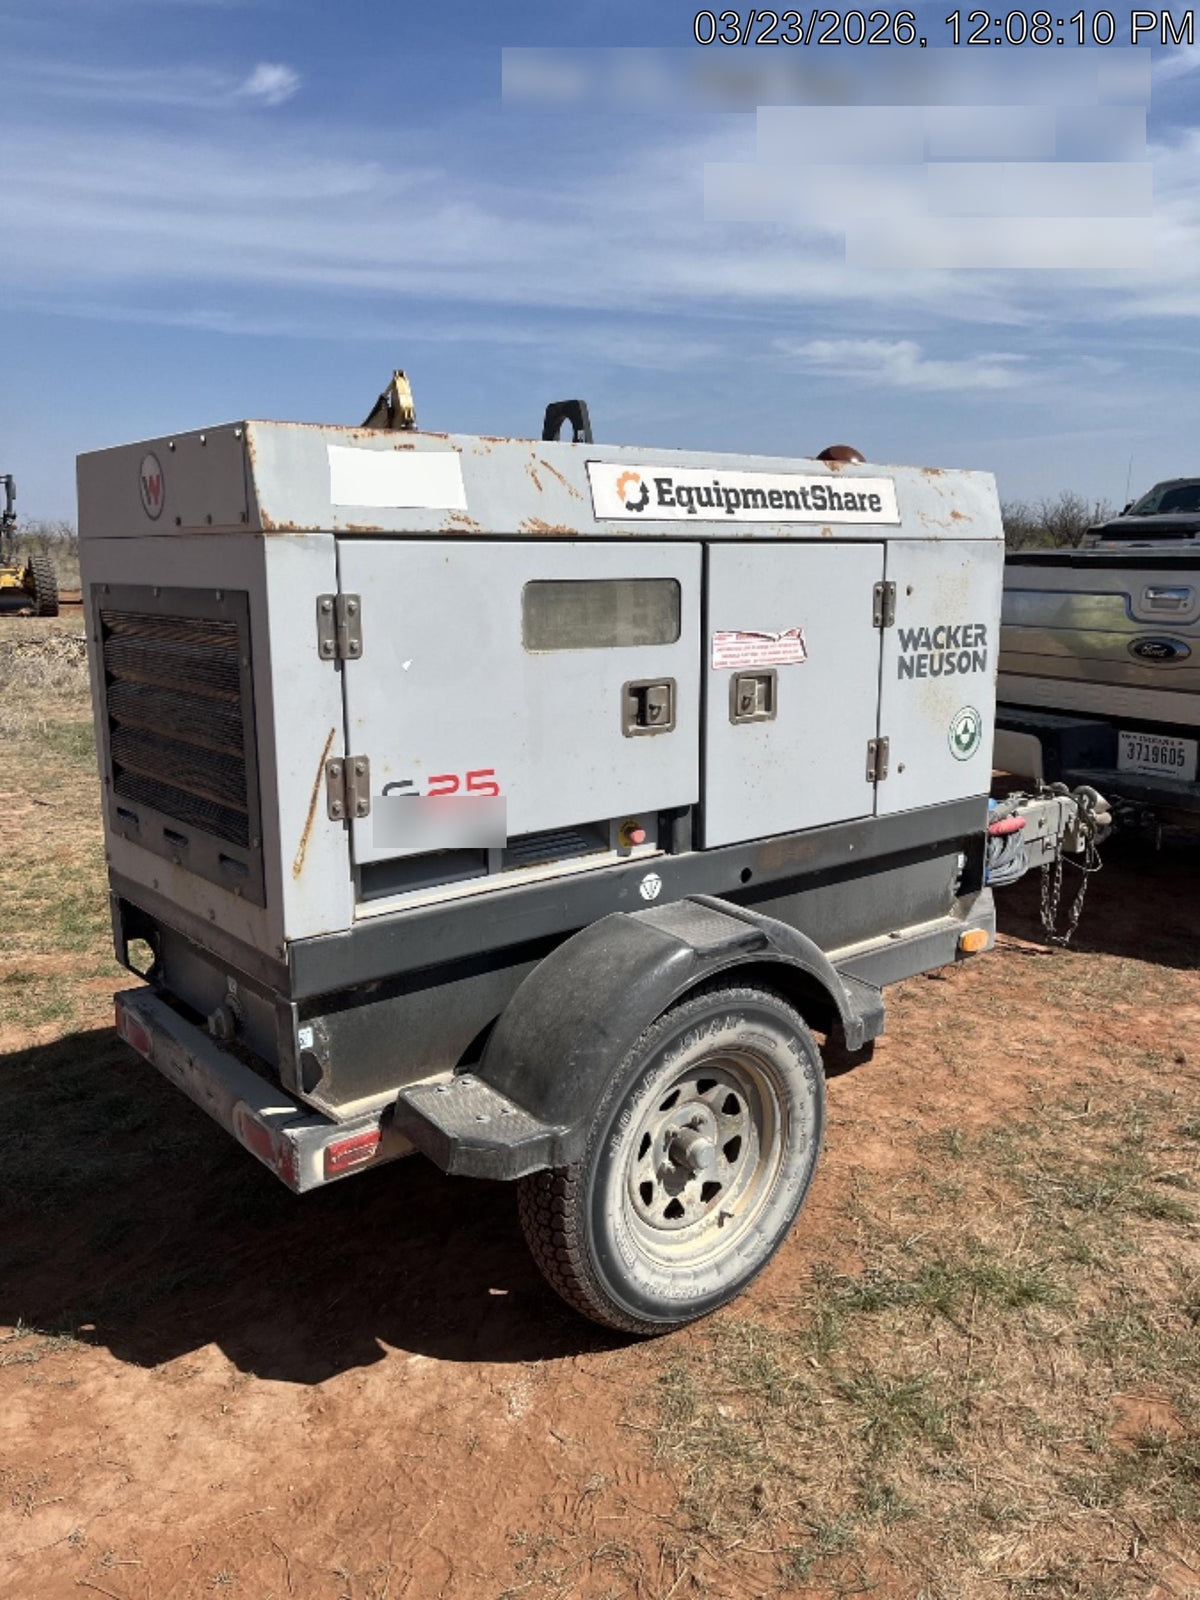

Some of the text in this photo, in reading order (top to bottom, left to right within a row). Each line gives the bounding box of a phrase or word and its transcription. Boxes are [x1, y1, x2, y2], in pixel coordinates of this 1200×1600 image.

[654, 477, 882, 514] EquipmentShare
[897, 623, 987, 653] WACKER
[897, 649, 987, 680] NEUSON
[1127, 742, 1185, 767] 3719605
